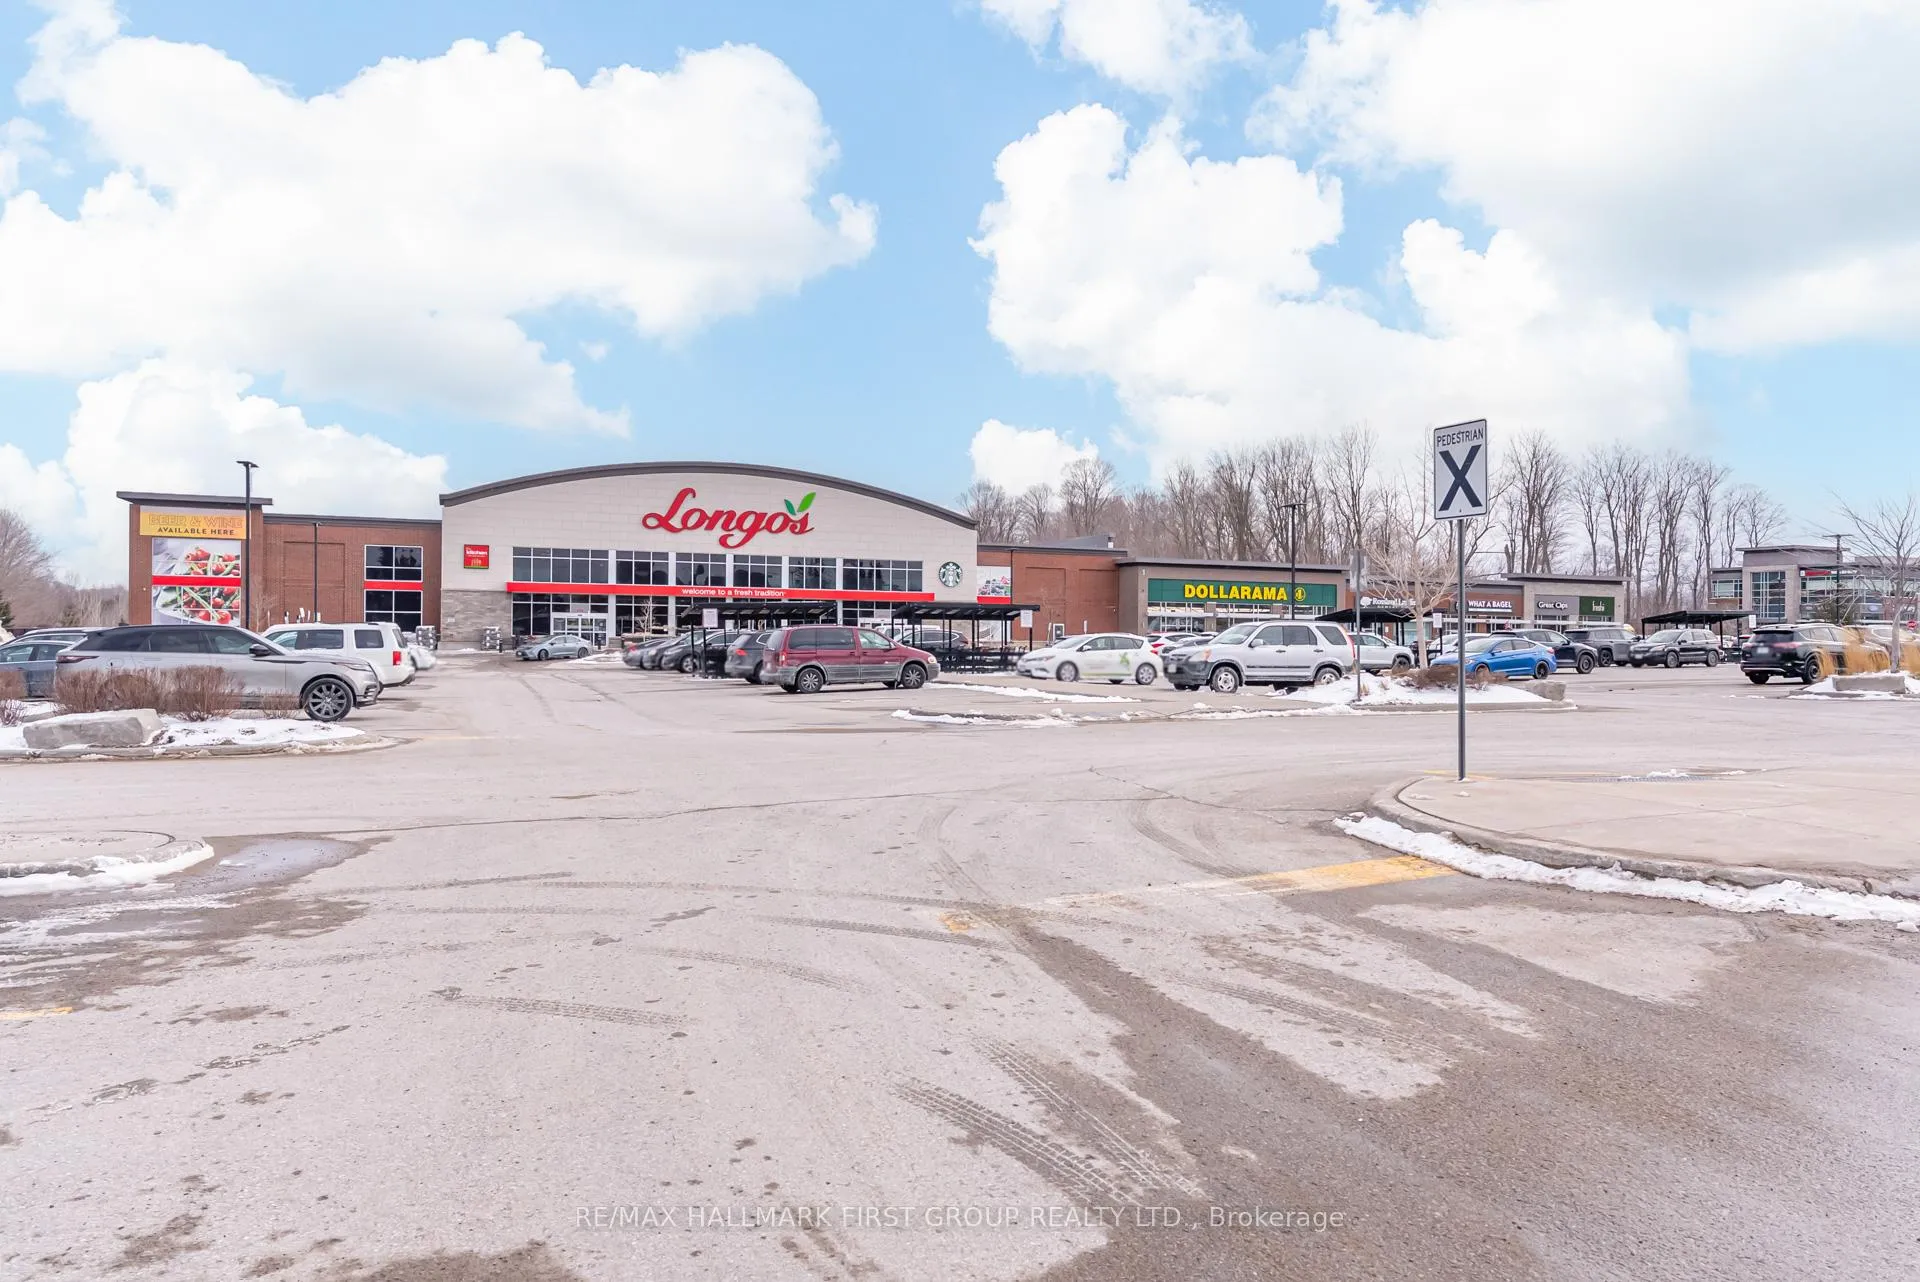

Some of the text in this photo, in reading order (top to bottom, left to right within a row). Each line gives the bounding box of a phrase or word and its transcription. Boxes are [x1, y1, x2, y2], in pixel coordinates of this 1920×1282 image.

[1437, 428, 1484, 447] PEDESTRIAN
[1438, 444, 1483, 511] X
[149, 514, 243, 528] BEER & WINE
[158, 527, 207, 535] AVAILABLE
[682, 588, 716, 596] welcome
[755, 589, 785, 597] tradition
[1184, 584, 1288, 601] DOLLARAMA
[1468, 600, 1513, 609] WHAT A BAGEL
[1538, 601, 1568, 611] Great Clips
